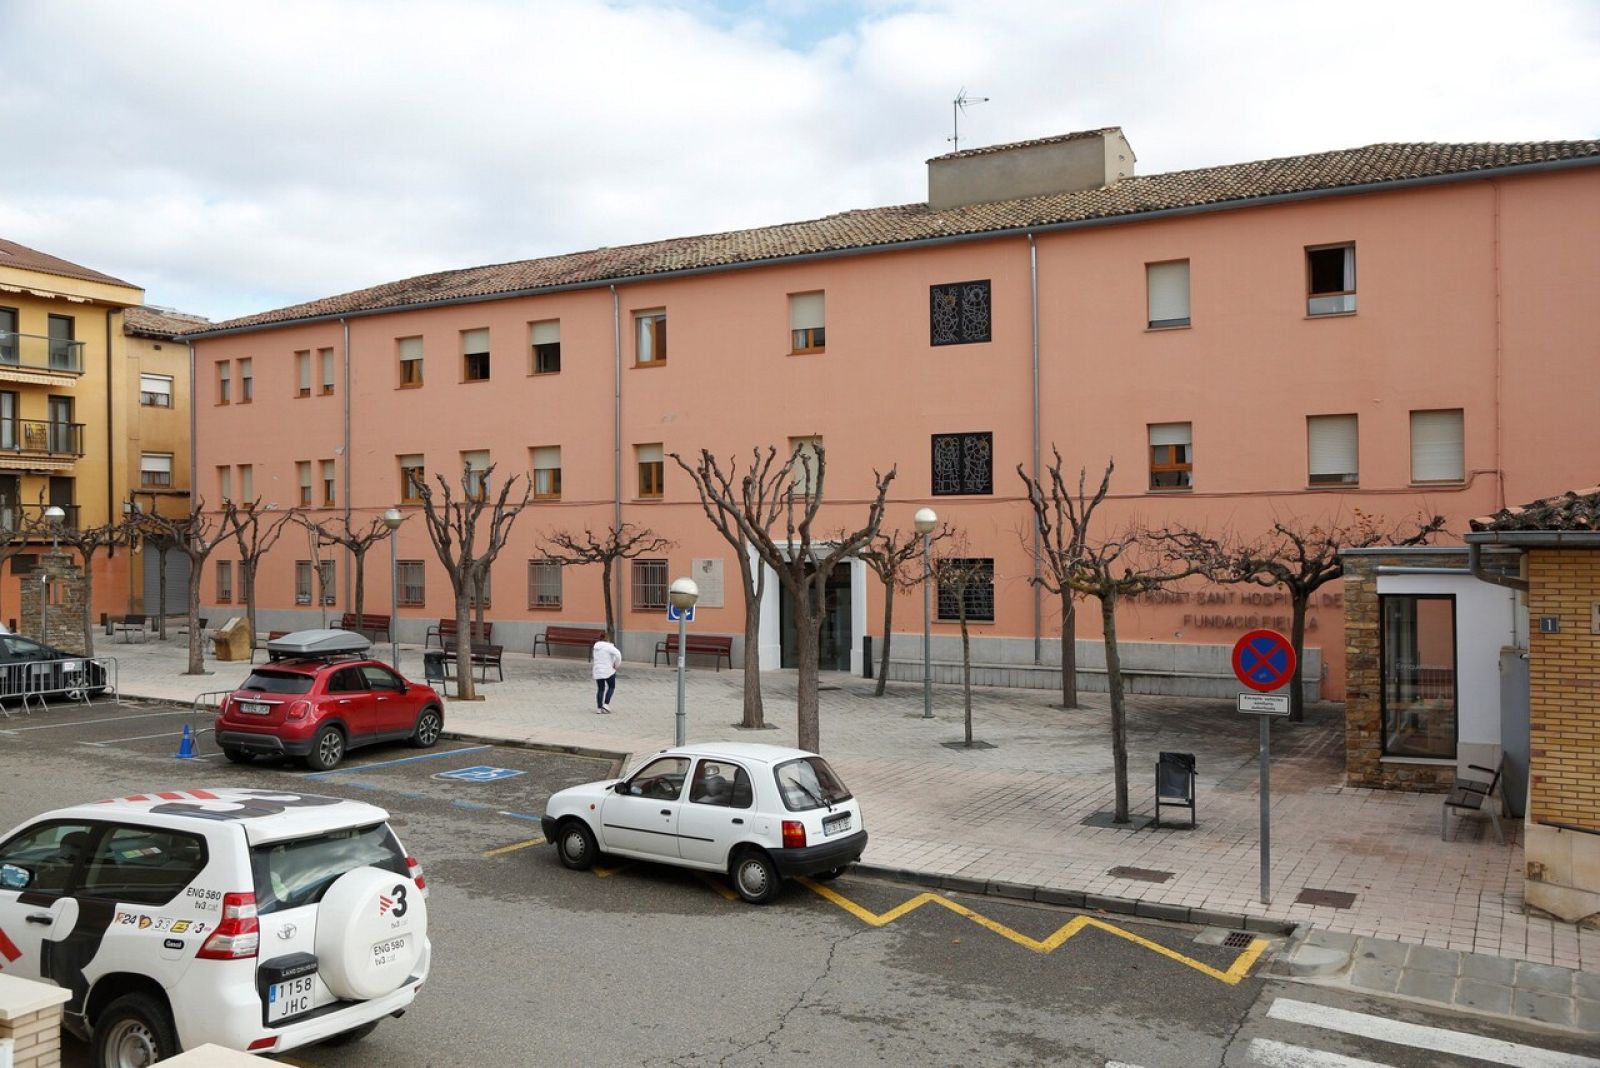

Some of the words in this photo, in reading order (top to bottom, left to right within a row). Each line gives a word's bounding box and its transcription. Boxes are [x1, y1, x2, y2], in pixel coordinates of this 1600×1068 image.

[1197, 592, 1236, 606] SANT
[1241, 592, 1318, 609] HOSPIL
[1321, 593, 1343, 608] DE
[1547, 618, 1552, 631] 1
[186, 887, 205, 898] ENG
[391, 884, 408, 918] 3
[373, 943, 391, 956] ENG
[390, 938, 405, 951] 580
[280, 977, 312, 999] 1158
[281, 996, 309, 1016] JHC
